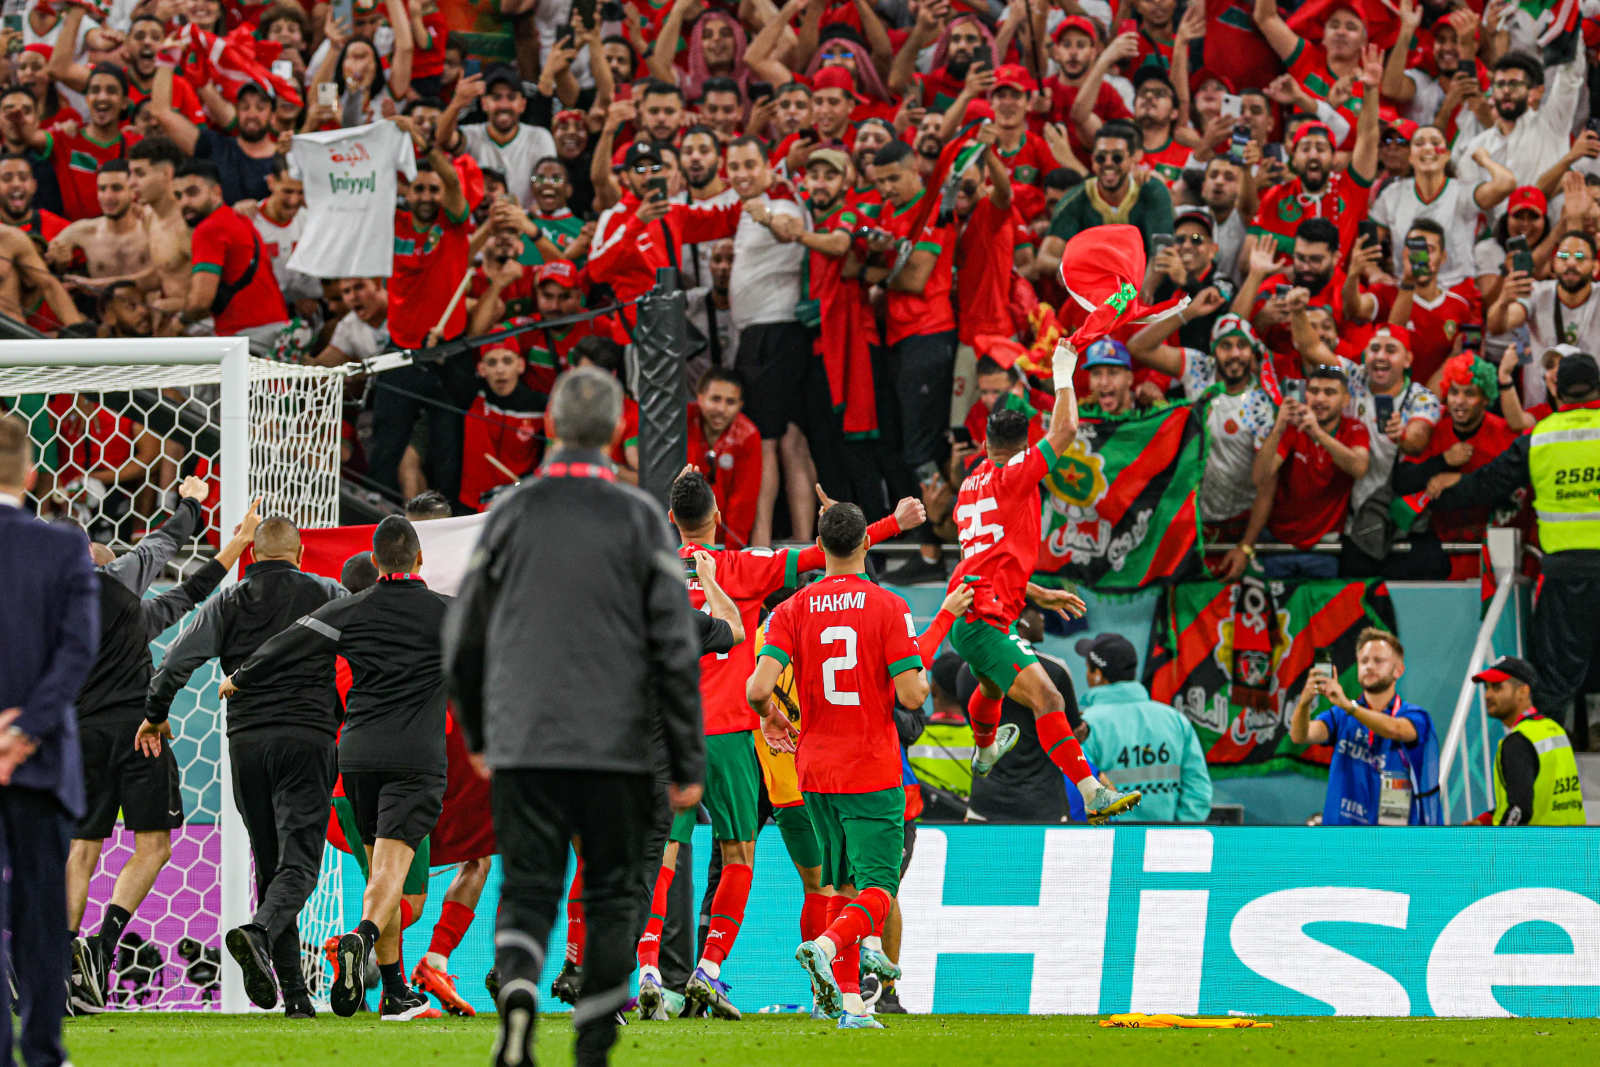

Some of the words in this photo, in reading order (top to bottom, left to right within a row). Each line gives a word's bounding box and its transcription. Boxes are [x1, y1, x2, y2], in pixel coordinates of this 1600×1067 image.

[957, 496, 1005, 559] 25
[809, 591, 866, 613] HAKIMI
[820, 625, 860, 706] 2
[1117, 742, 1170, 768] 4166
[895, 829, 1600, 1017] Hise
